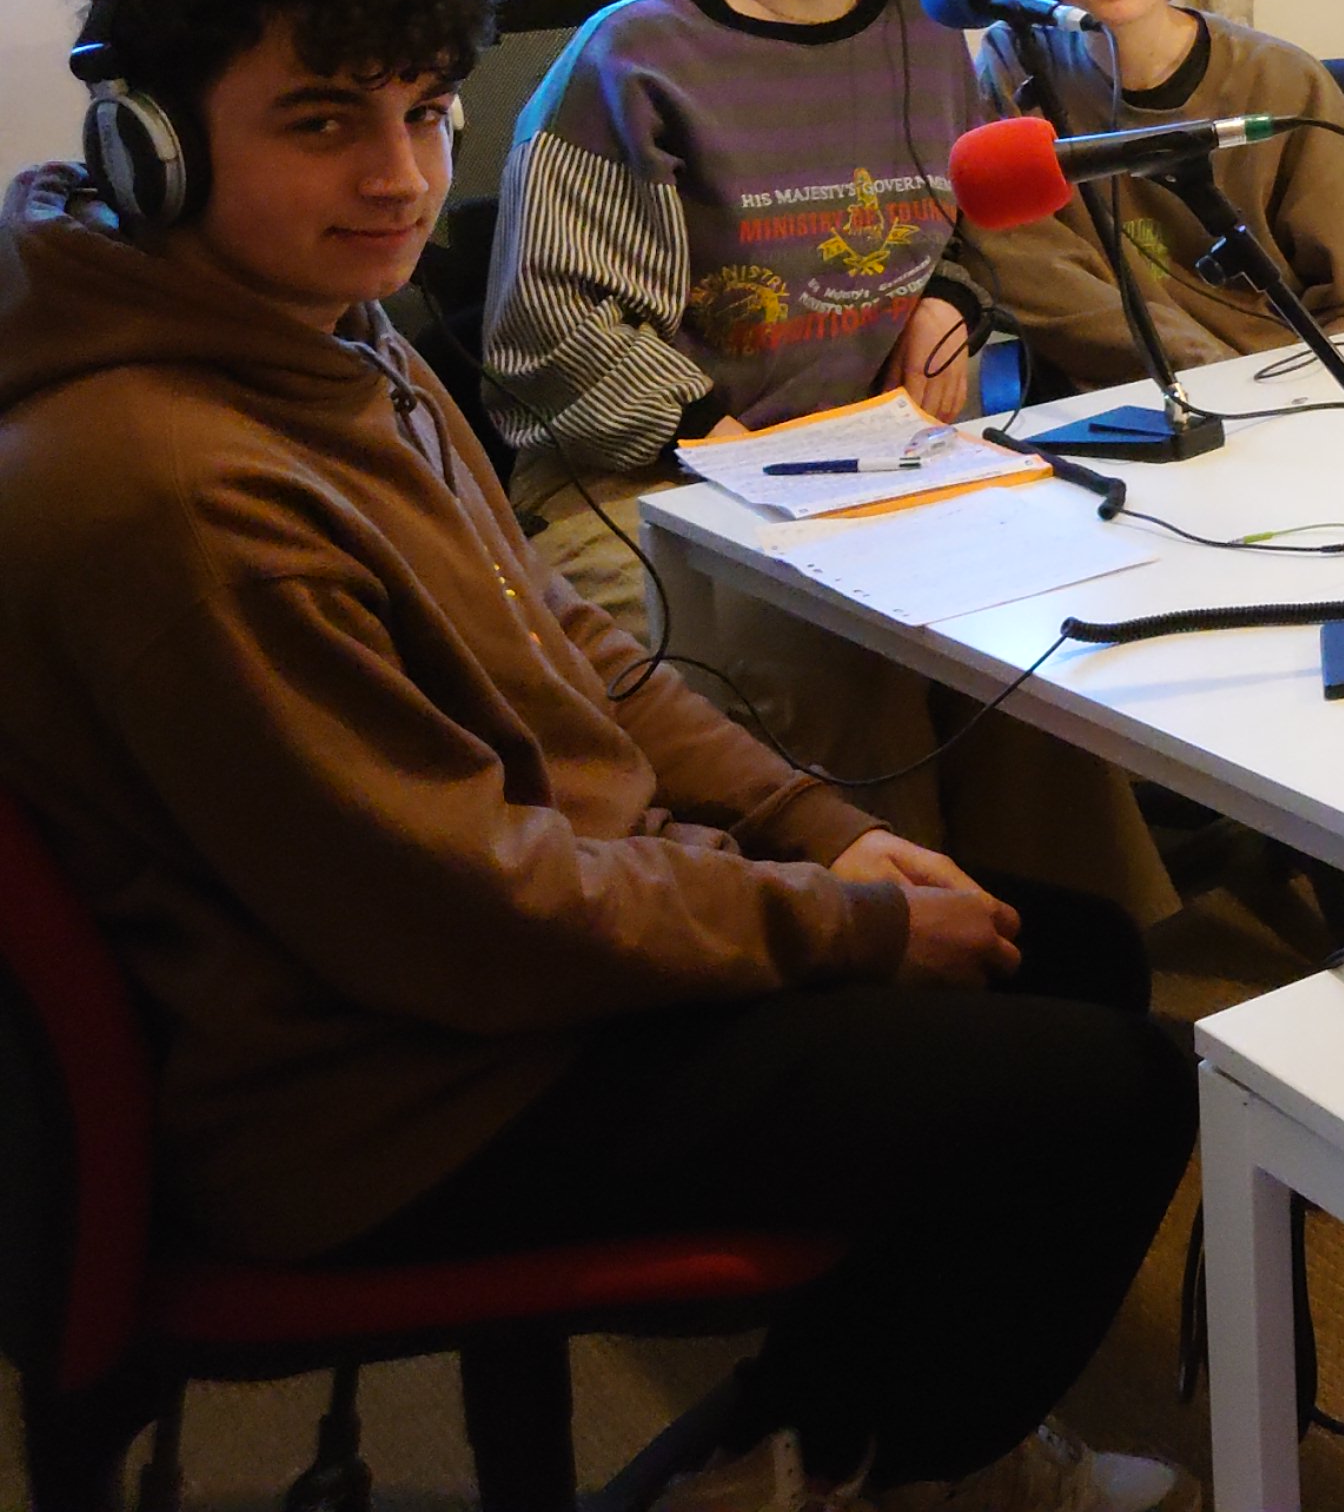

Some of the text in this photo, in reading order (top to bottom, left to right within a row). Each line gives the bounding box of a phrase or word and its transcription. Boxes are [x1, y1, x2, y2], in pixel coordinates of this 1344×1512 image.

[741, 192, 772, 208] HIS
[775, 181, 856, 204] MAJESTY'S
[739, 209, 843, 244] MINISTRY
